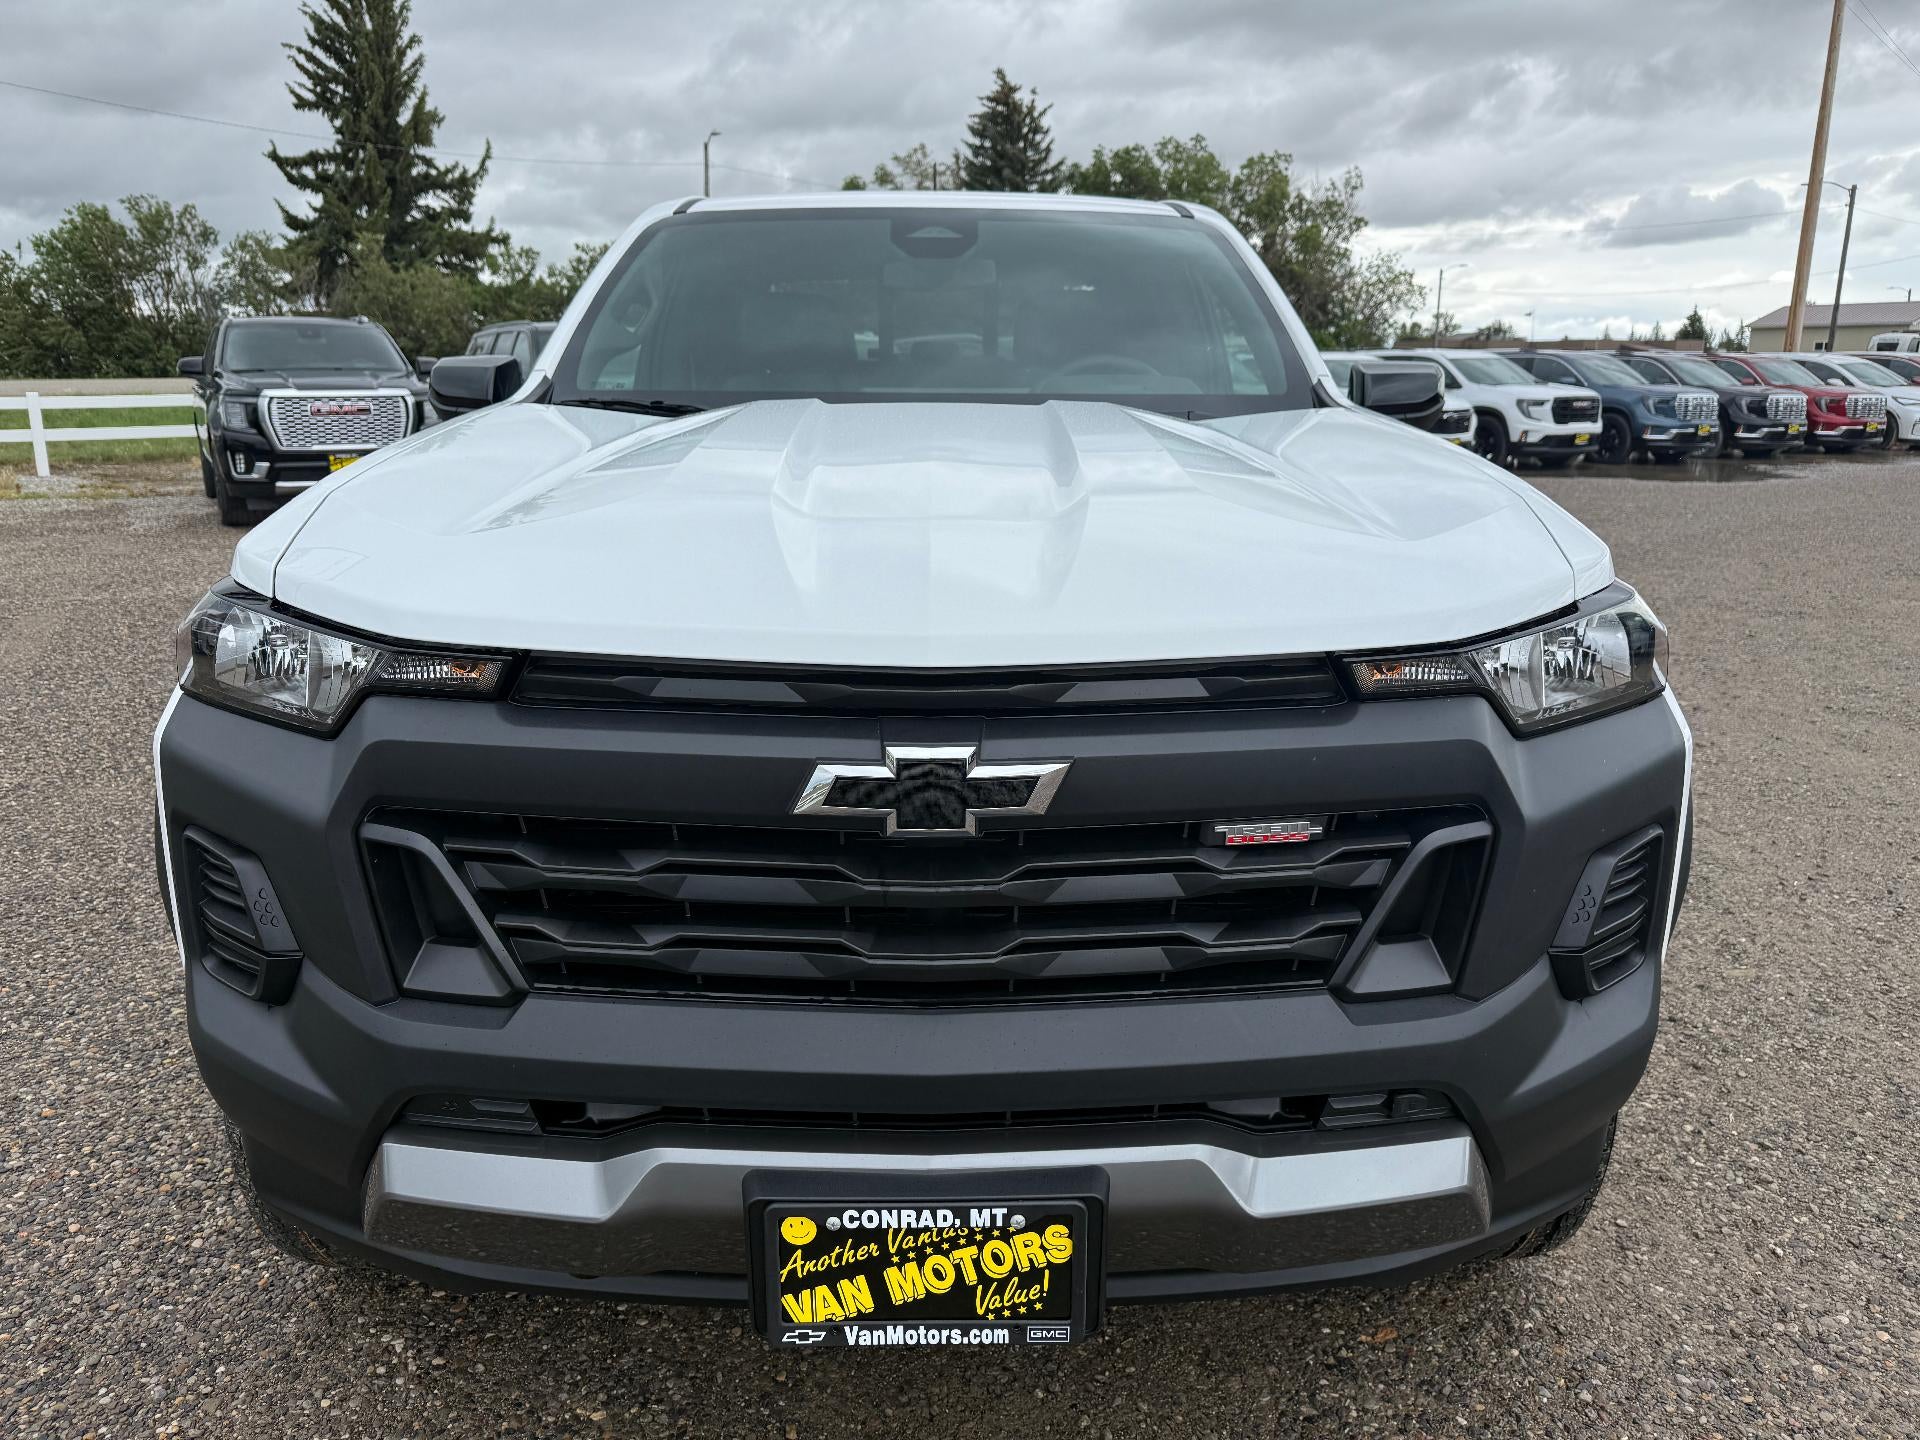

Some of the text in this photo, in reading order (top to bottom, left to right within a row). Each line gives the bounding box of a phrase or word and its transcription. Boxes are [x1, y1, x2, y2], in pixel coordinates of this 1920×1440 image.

[842, 1208, 1008, 1229] CONRAD, MT
[780, 1238, 880, 1283] Another
[780, 1224, 1073, 1324] VAN MOTORS
[975, 1269, 1050, 1316] Value!
[843, 1325, 1010, 1346] VanMotors.com
[1030, 1330, 1067, 1338] GMC
